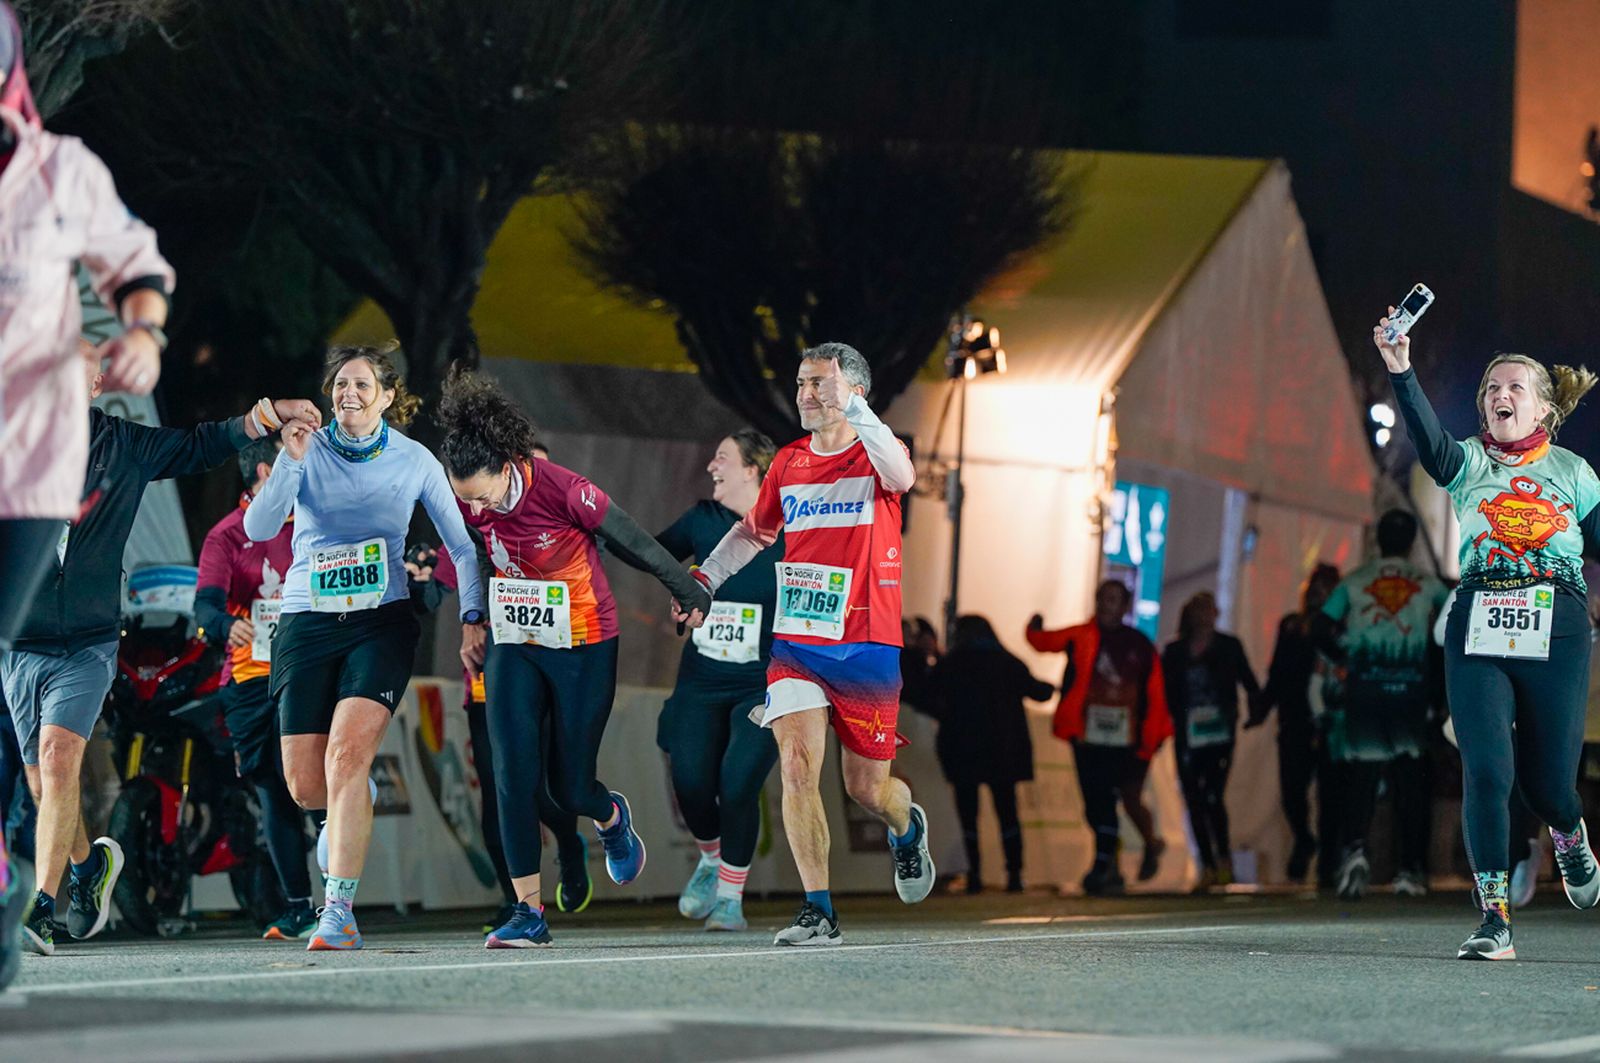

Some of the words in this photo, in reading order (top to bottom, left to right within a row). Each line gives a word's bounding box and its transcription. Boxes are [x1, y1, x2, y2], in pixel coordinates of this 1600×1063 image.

[797, 501, 864, 518] Avanza
[326, 551, 348, 562] NOCHE
[348, 550, 359, 559] DE
[317, 562, 333, 571] SAN
[333, 558, 359, 568] ANTÓN
[318, 563, 379, 590] 12988
[793, 570, 813, 580] NOCHE
[814, 572, 824, 582] DE
[785, 578, 799, 587] SAN
[799, 579, 823, 590] ANTÓN
[506, 587, 529, 596] NOCHE
[530, 588, 540, 596] DE
[1492, 590, 1517, 599] NOCHE
[1518, 590, 1528, 598] DE
[497, 595, 513, 604] SAN
[513, 595, 540, 605] ANTÓN
[1482, 598, 1499, 607] SAN
[1499, 597, 1528, 607] ANTÓN
[504, 604, 555, 628] 3824
[1487, 606, 1541, 631] 3551
[709, 624, 745, 643] 1234
